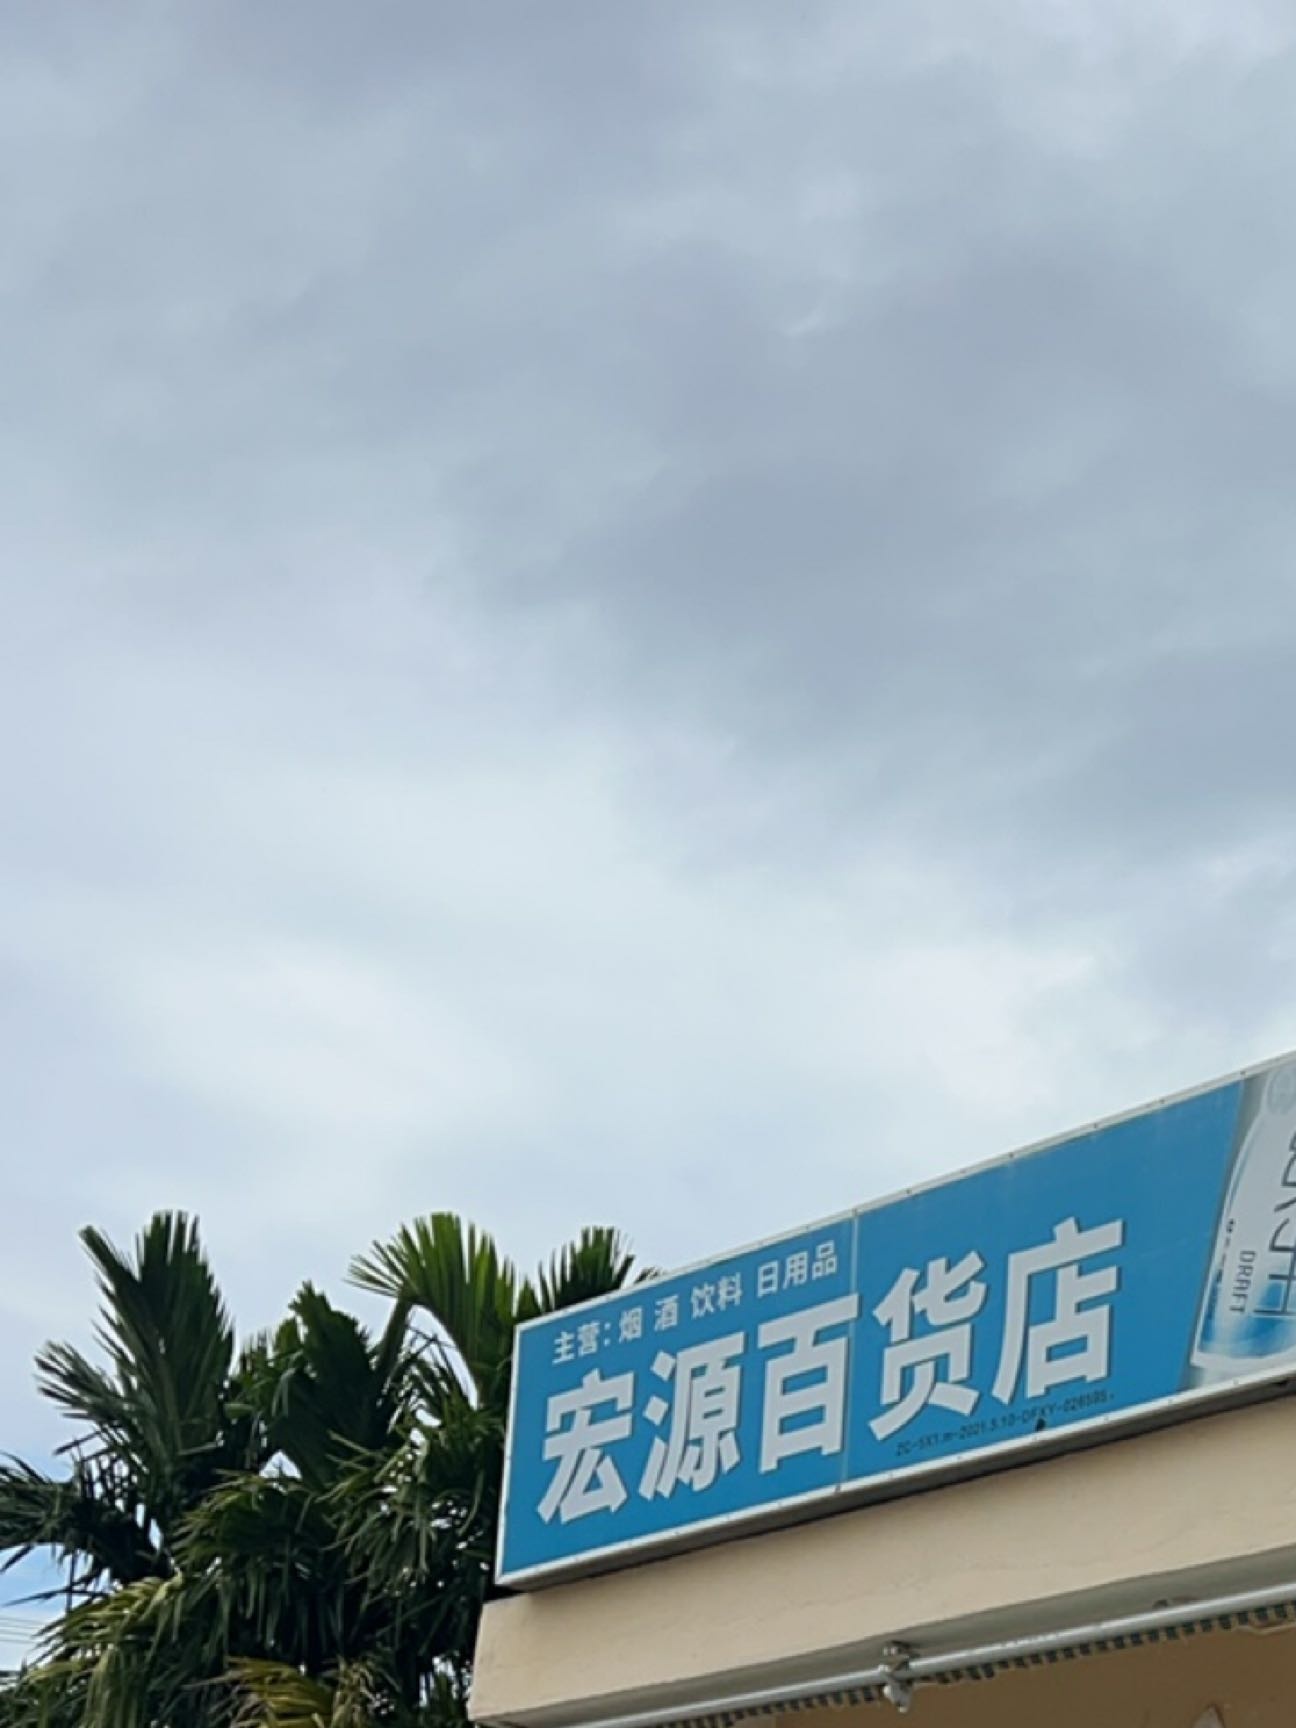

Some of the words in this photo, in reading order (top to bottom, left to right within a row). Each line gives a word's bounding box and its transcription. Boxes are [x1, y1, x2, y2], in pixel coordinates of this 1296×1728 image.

[654, 1295, 680, 1331] 酒
[690, 1273, 743, 1319] 饮料
[757, 1240, 838, 1297] 日用品
[1229, 1250, 1256, 1315] DRAFT
[537, 1216, 1123, 1525] 宏源百货店
